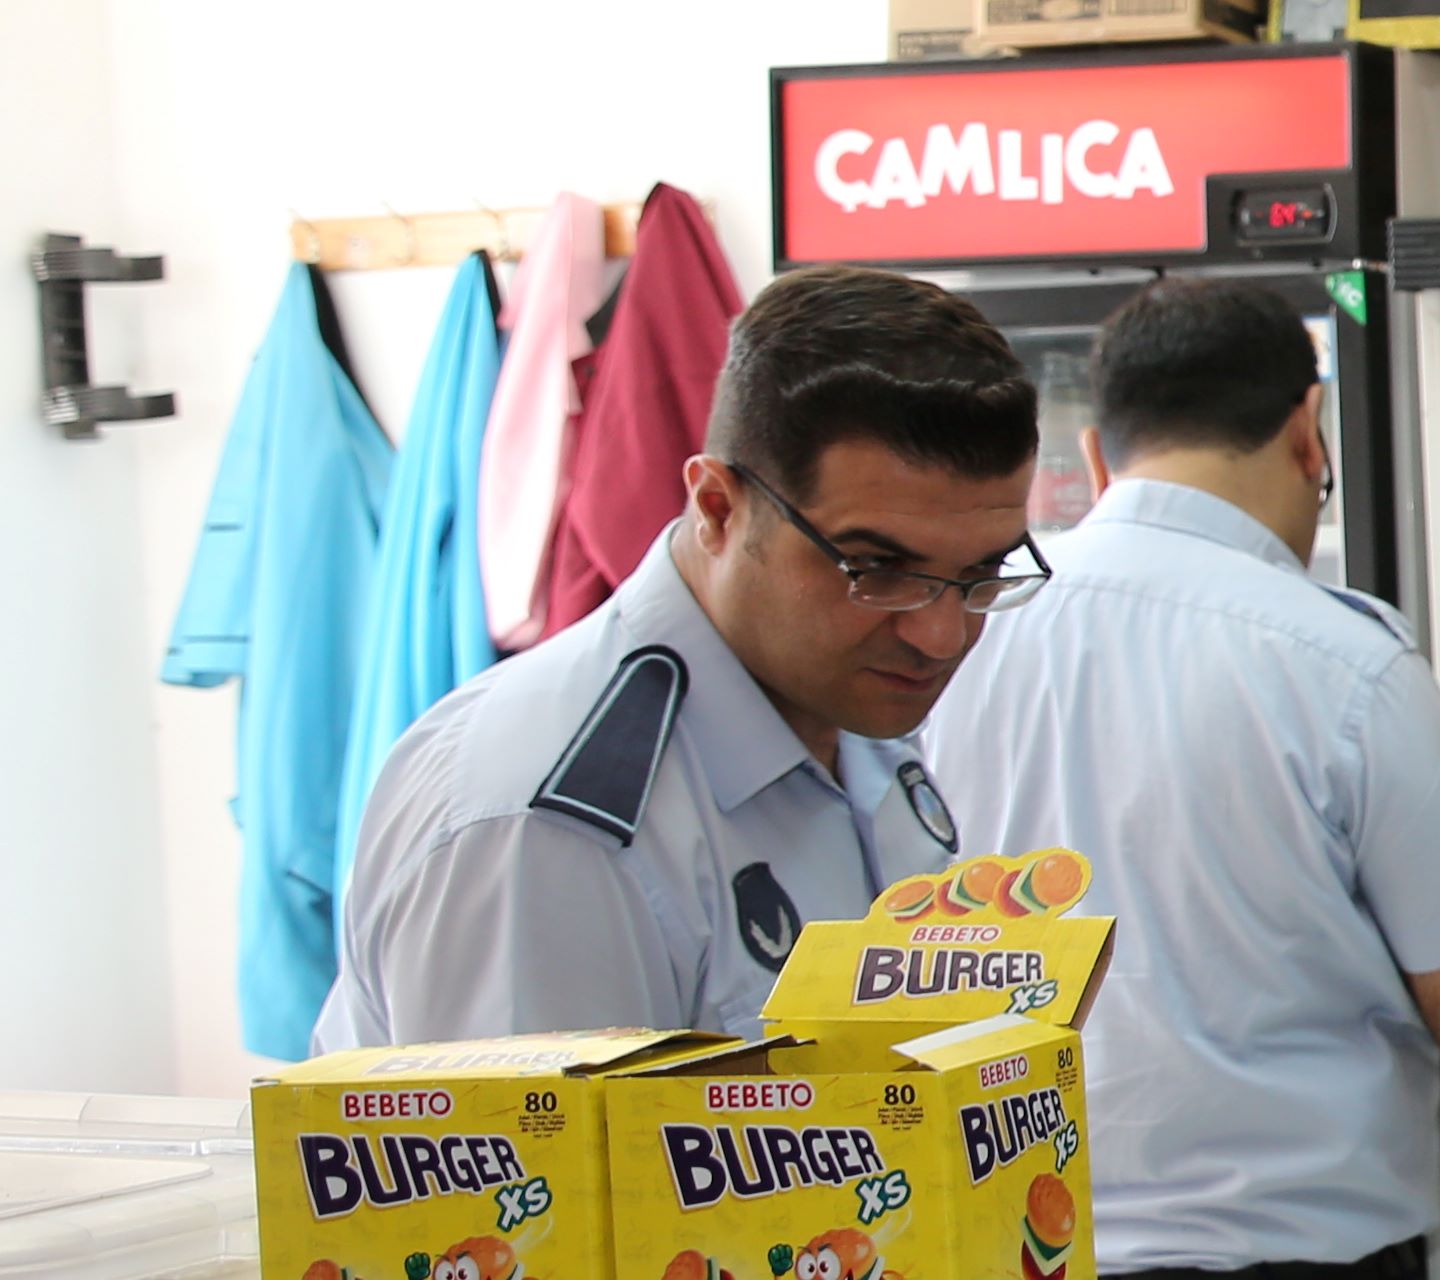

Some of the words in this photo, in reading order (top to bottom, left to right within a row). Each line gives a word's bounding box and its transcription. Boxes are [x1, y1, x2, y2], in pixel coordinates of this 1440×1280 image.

[813, 119, 1175, 212] ÇAMLICA
[910, 923, 1001, 944] BEBETO
[853, 946, 1044, 1006] BURGER
[1004, 979, 1061, 1017] XS
[707, 1082, 814, 1110] BEBETO
[884, 1084, 917, 1105] 80
[980, 1055, 1029, 1089] BEBETO
[1056, 1048, 1075, 1069] 80
[343, 1091, 453, 1119] BEBETO
[525, 1091, 558, 1114] 80
[959, 1090, 1067, 1187] BURGER
[1053, 1120, 1080, 1173] XS
[298, 1134, 527, 1219] BURGER
[661, 1124, 885, 1212] BURGER
[494, 1176, 552, 1233] XS
[855, 1169, 911, 1226] XS
